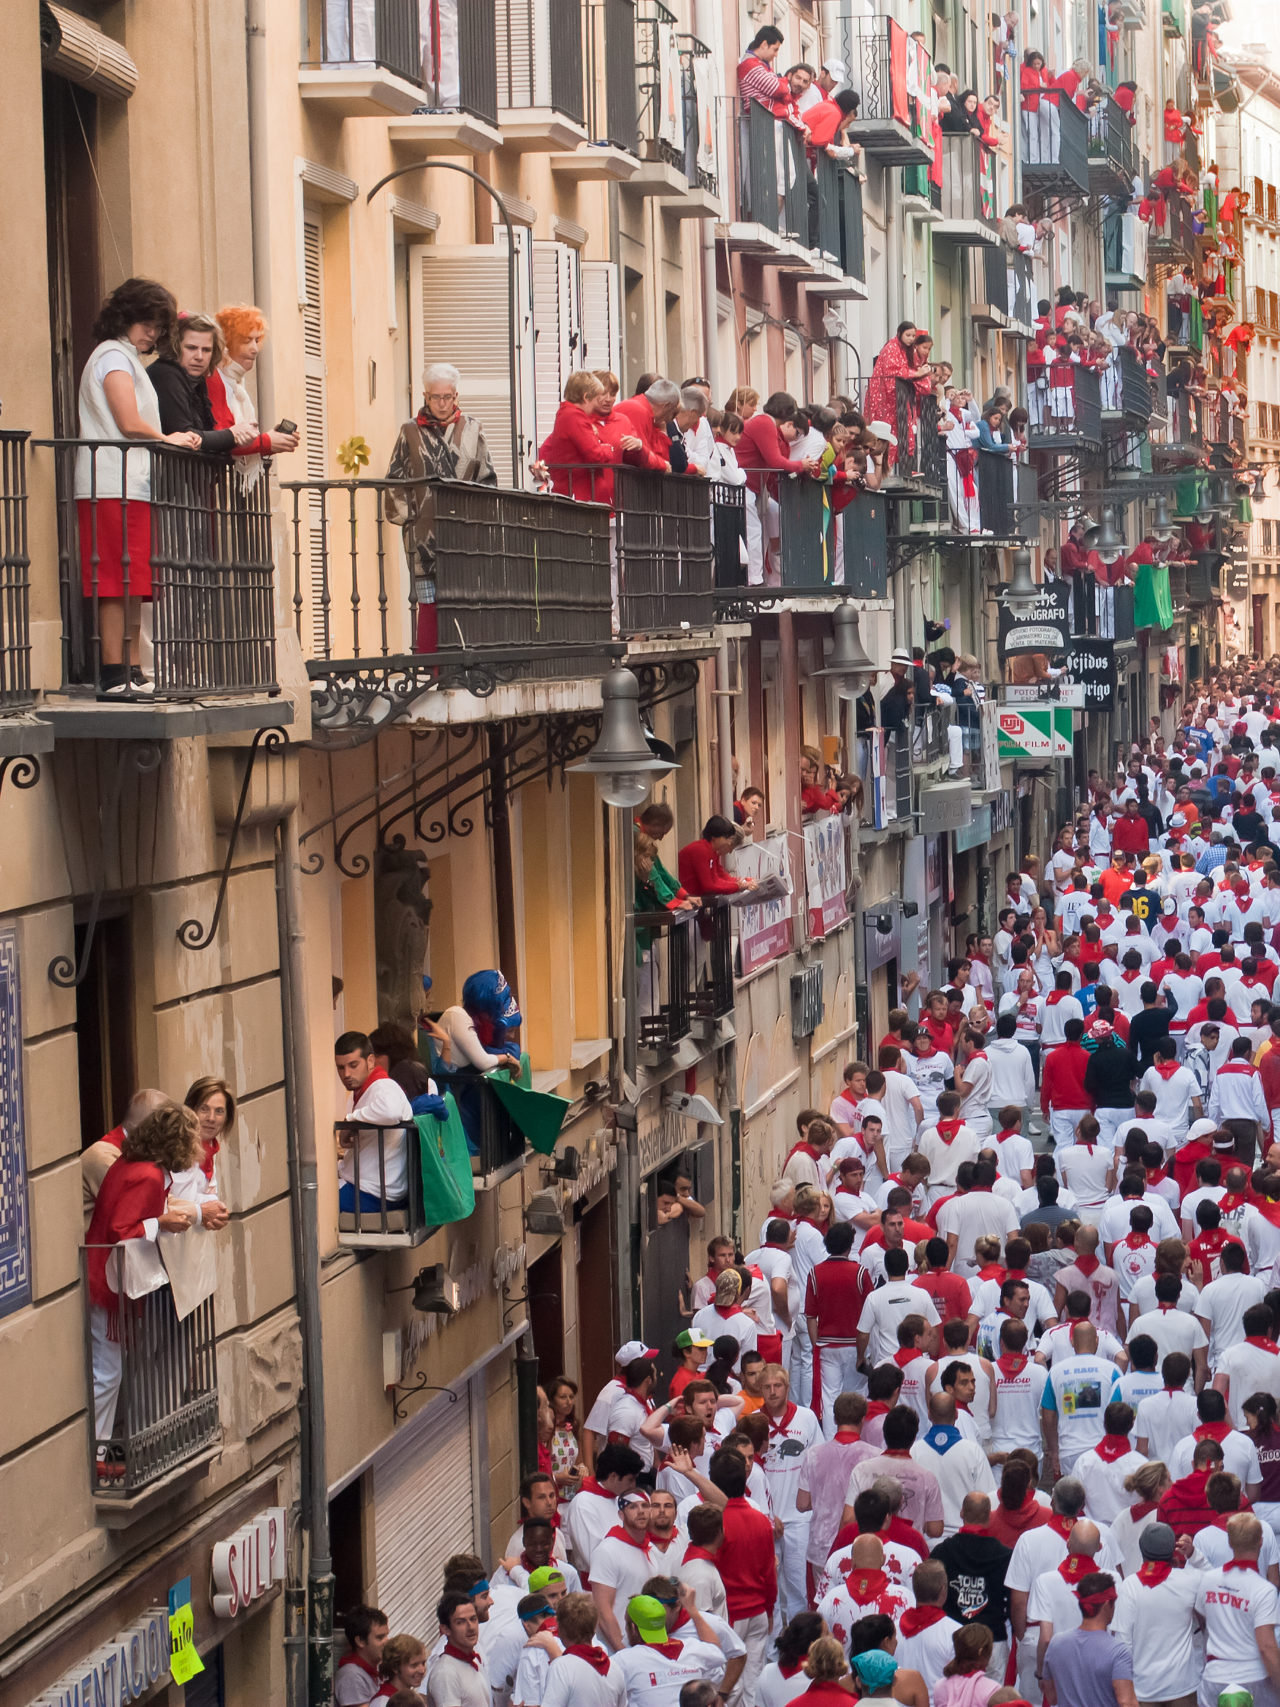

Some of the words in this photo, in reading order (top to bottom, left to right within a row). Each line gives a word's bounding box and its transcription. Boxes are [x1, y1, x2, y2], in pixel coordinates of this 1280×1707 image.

[957, 1575, 985, 1589] TOUR
[957, 1592, 984, 1605] AUTO
[1205, 1590, 1250, 1613] RUN!
